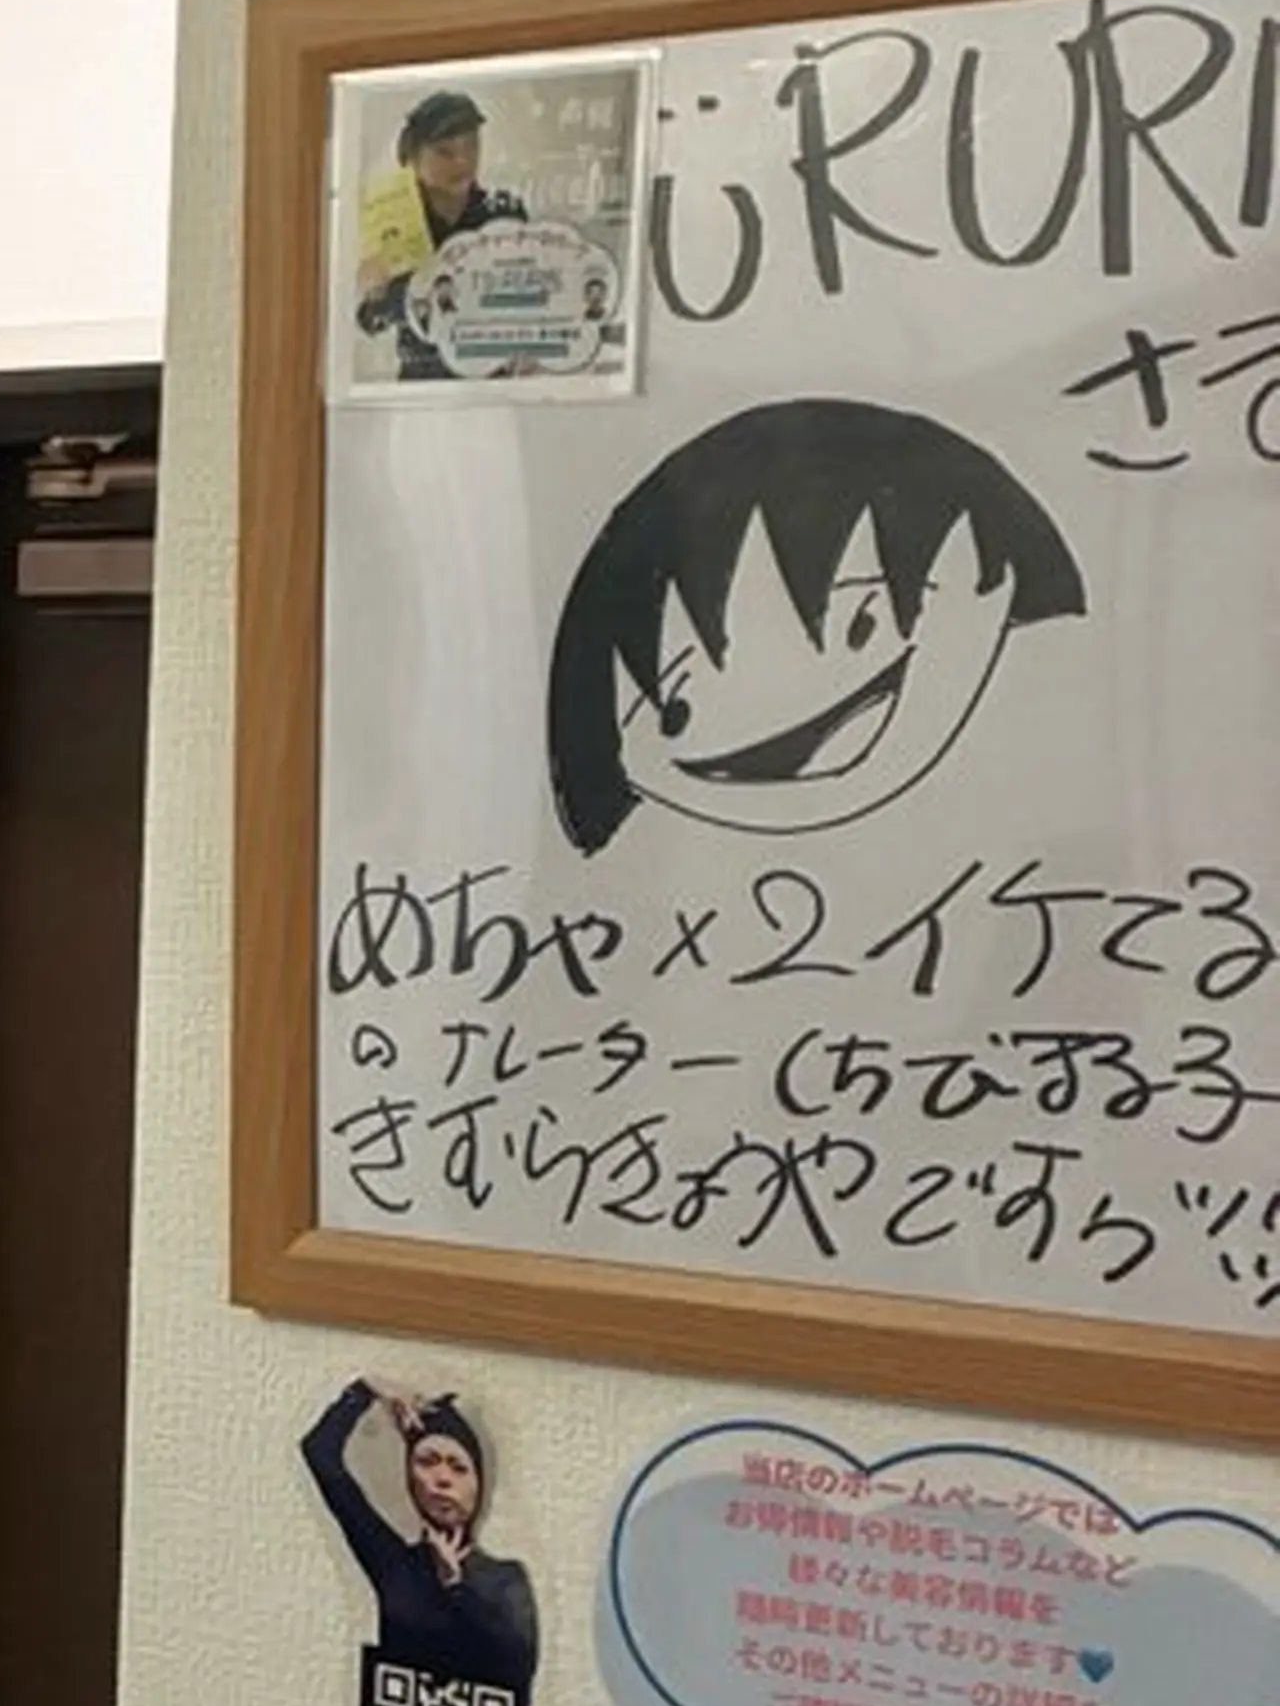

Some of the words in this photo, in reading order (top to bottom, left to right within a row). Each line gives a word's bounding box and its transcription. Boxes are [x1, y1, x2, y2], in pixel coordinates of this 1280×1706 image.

[742, 1451, 1120, 1537] 当店のホームページでは
